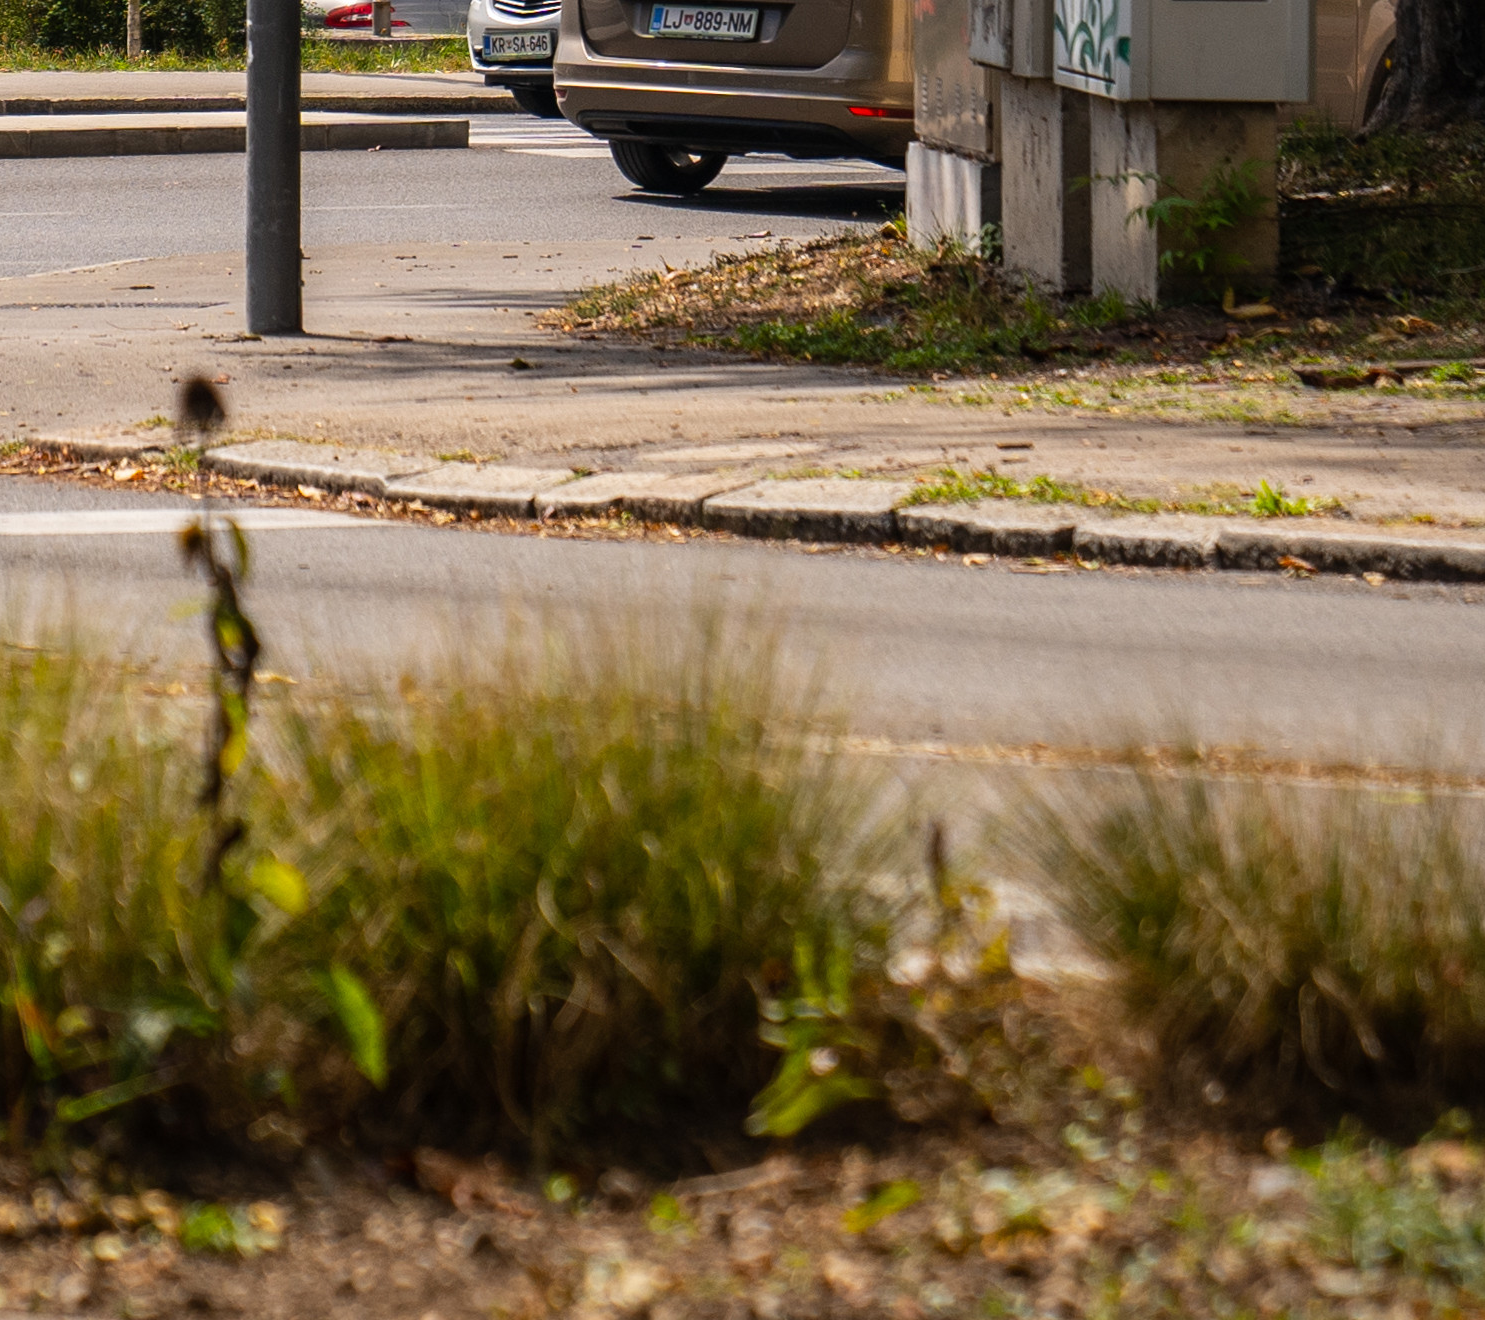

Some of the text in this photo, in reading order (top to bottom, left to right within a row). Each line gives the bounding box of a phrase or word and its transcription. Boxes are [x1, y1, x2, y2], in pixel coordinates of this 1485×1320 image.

[663, 9, 753, 33] LJ 889-NM
[491, 35, 548, 53] KR SA-646
